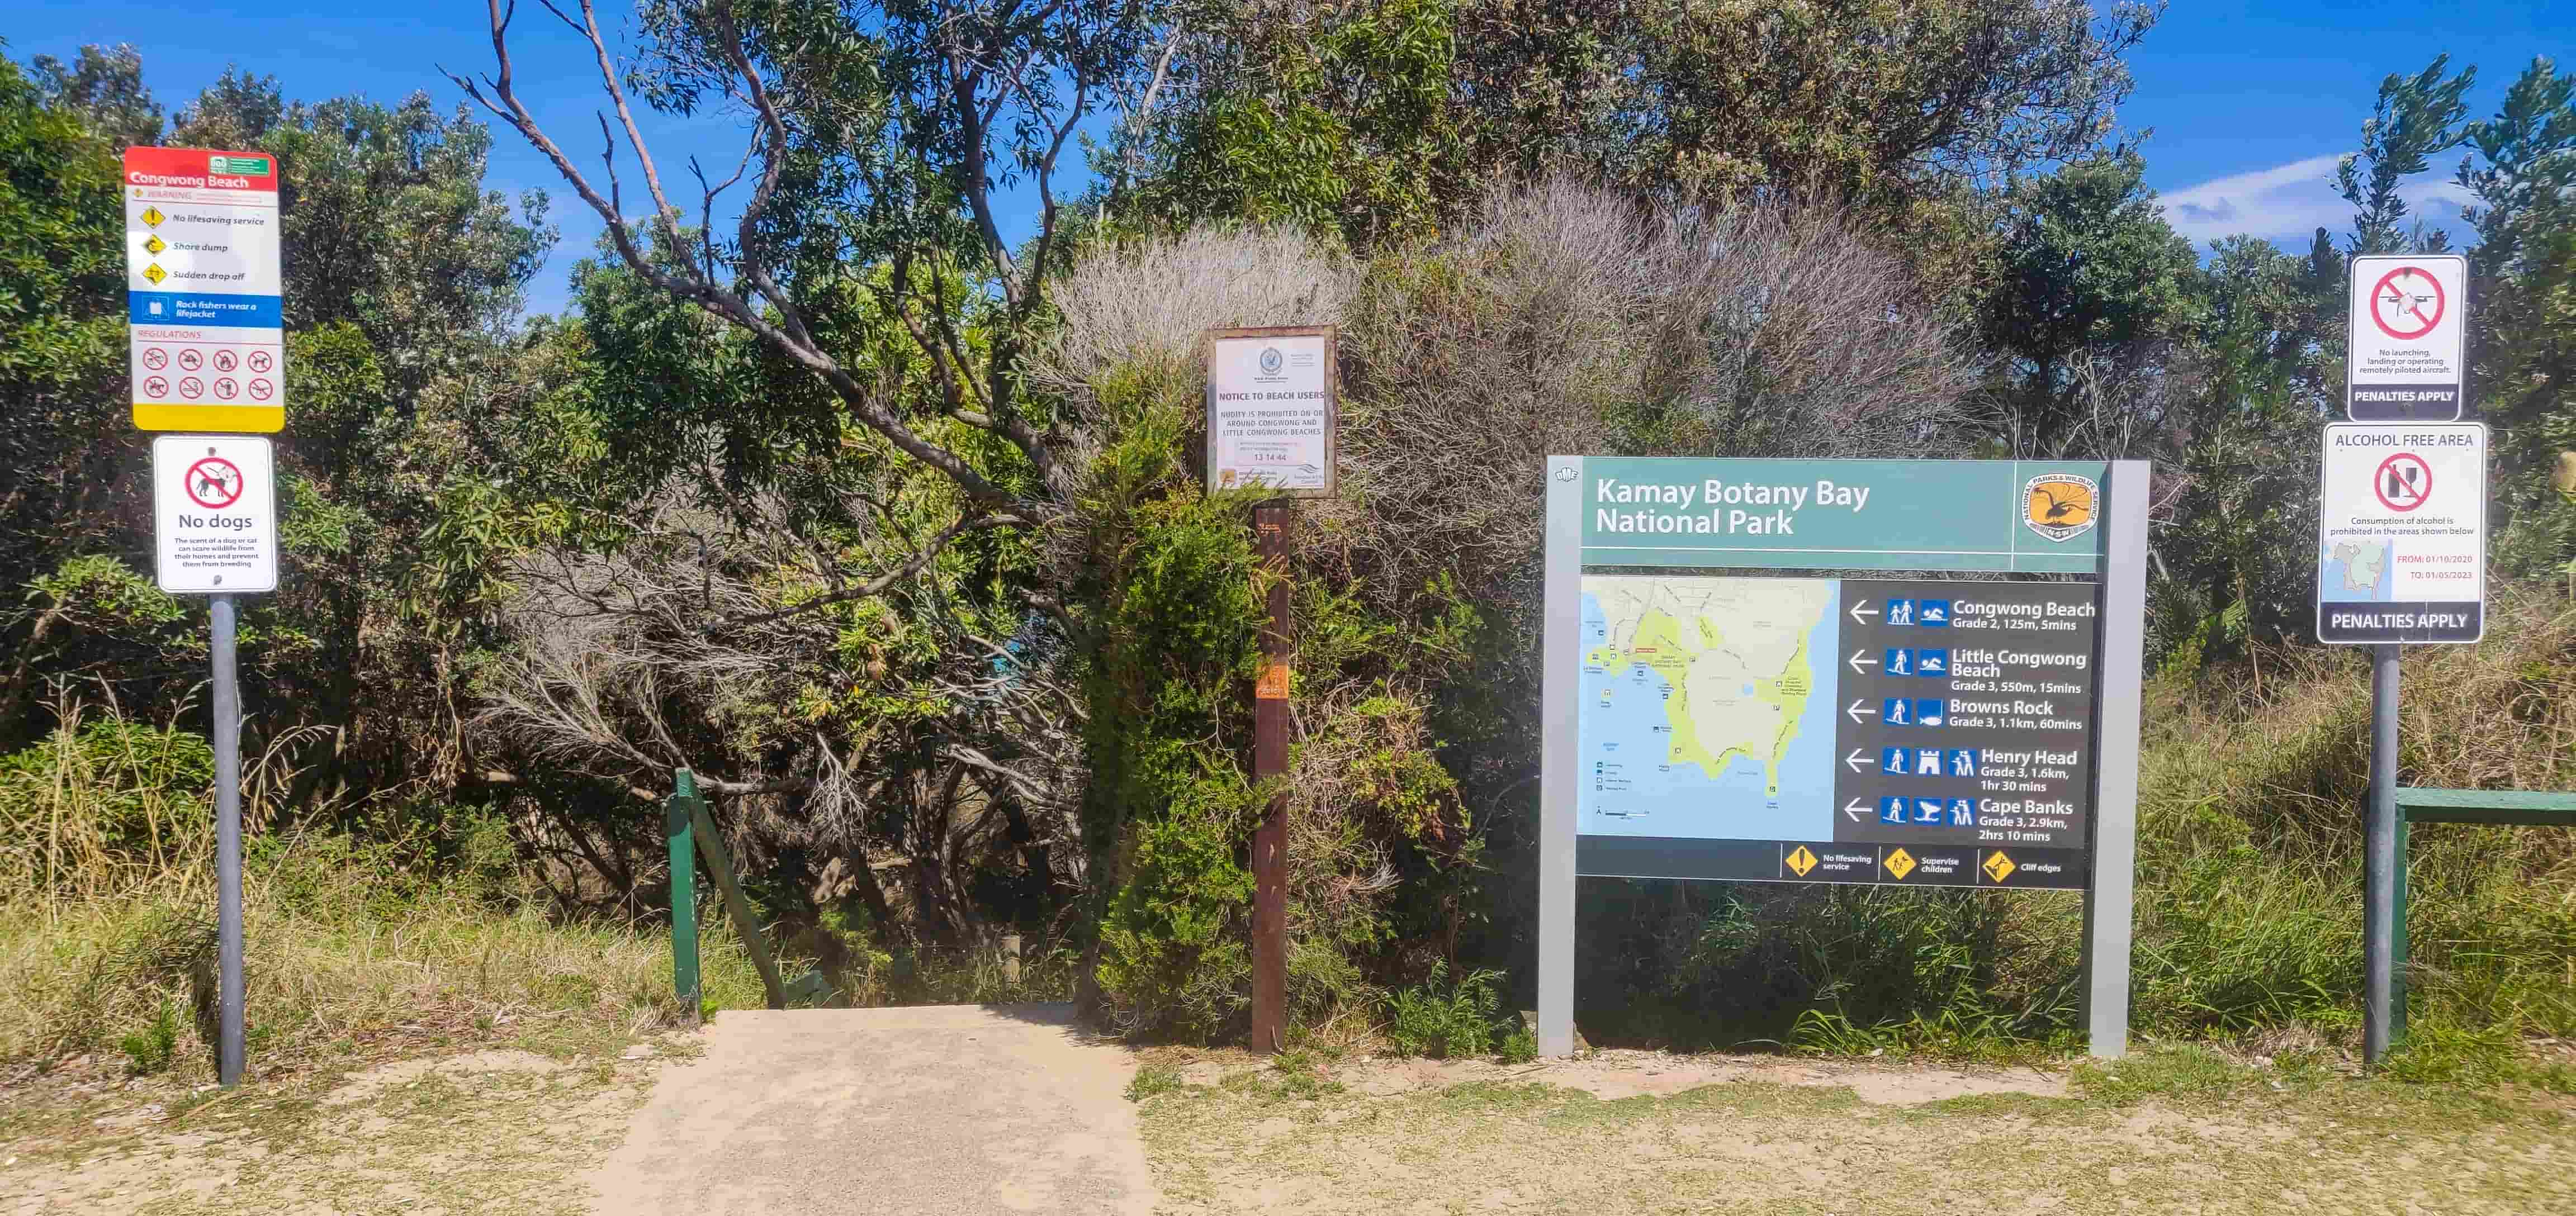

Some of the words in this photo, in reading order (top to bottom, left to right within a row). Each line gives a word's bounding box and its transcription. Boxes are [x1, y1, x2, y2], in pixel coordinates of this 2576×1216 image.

[130, 172, 206, 188] Congwong
[208, 175, 249, 188] Beach
[187, 215, 231, 225] lifesaving
[202, 244, 228, 253] dump
[210, 272, 229, 281] drop
[176, 310, 216, 319] lifejacket
[138, 330, 201, 339] REGULATIONS
[2355, 392, 2415, 401] PENALTIES
[2418, 392, 2454, 401] APPLY
[2336, 434, 2399, 446] ALCOHOL
[2404, 434, 2434, 446] FREE
[2438, 434, 2473, 446] AREA
[1597, 479, 1697, 510] Kamay
[1704, 479, 1808, 511] Botany
[1816, 481, 1870, 512] Bay
[2023, 481, 2033, 520] NATIONAL
[2065, 476, 2095, 489] WILDLIFE
[179, 515, 203, 528] No
[209, 514, 252, 531] dogs
[1597, 509, 1720, 534] National
[1730, 510, 1794, 535] Park
[2351, 517, 2404, 526] Consumption
[2331, 528, 2372, 536] prohibited
[1953, 600, 2042, 618] Congwong
[2047, 602, 2096, 617] Beach
[1953, 618, 1987, 629] Grade
[1990, 620, 2000, 630] 2,
[2004, 620, 2039, 631] 125m,
[2042, 620, 2076, 630] 5mins
[2332, 614, 2413, 628] PENALTIES
[2417, 614, 2468, 628] APPLY
[1952, 649, 1993, 664] Little
[1997, 650, 2087, 669] Congwong
[1952, 663, 2000, 677] Beach
[1951, 681, 1986, 691] Grade
[1987, 682, 1999, 692] 3,
[2001, 683, 2037, 694] 550m,
[2040, 683, 2081, 694] 15mins
[1950, 700, 2009, 714] Browns
[2014, 701, 2053, 715] Rock
[1949, 716, 1984, 727] Grade
[1985, 718, 1996, 728] 3,
[1999, 718, 2037, 729] 1.1km,
[2040, 719, 2082, 730] 60mins
[1981, 749, 2030, 766] Henry
[2035, 750, 2077, 764] Head
[1981, 767, 2015, 777] Grade
[2017, 768, 2028, 778] 3,
[2032, 768, 2070, 780] 1.6km,
[1981, 781, 1999, 791] 1hr
[2002, 781, 2016, 791] 30
[2019, 781, 2047, 792] mins
[1980, 799, 2021, 815] Cape
[2026, 800, 2073, 815] Banks
[1979, 816, 2014, 827] Grade
[2016, 818, 2026, 828] 3,
[2029, 818, 2067, 829] 2.9km,
[1978, 830, 2004, 840] 2hrs
[2007, 831, 2020, 841] 10
[2023, 832, 2050, 842] mins
[1836, 854, 1872, 864] lifesaving
[1921, 857, 1959, 866] Supervise
[2021, 863, 2036, 872] Cliff
[2038, 864, 2061, 873] edges
